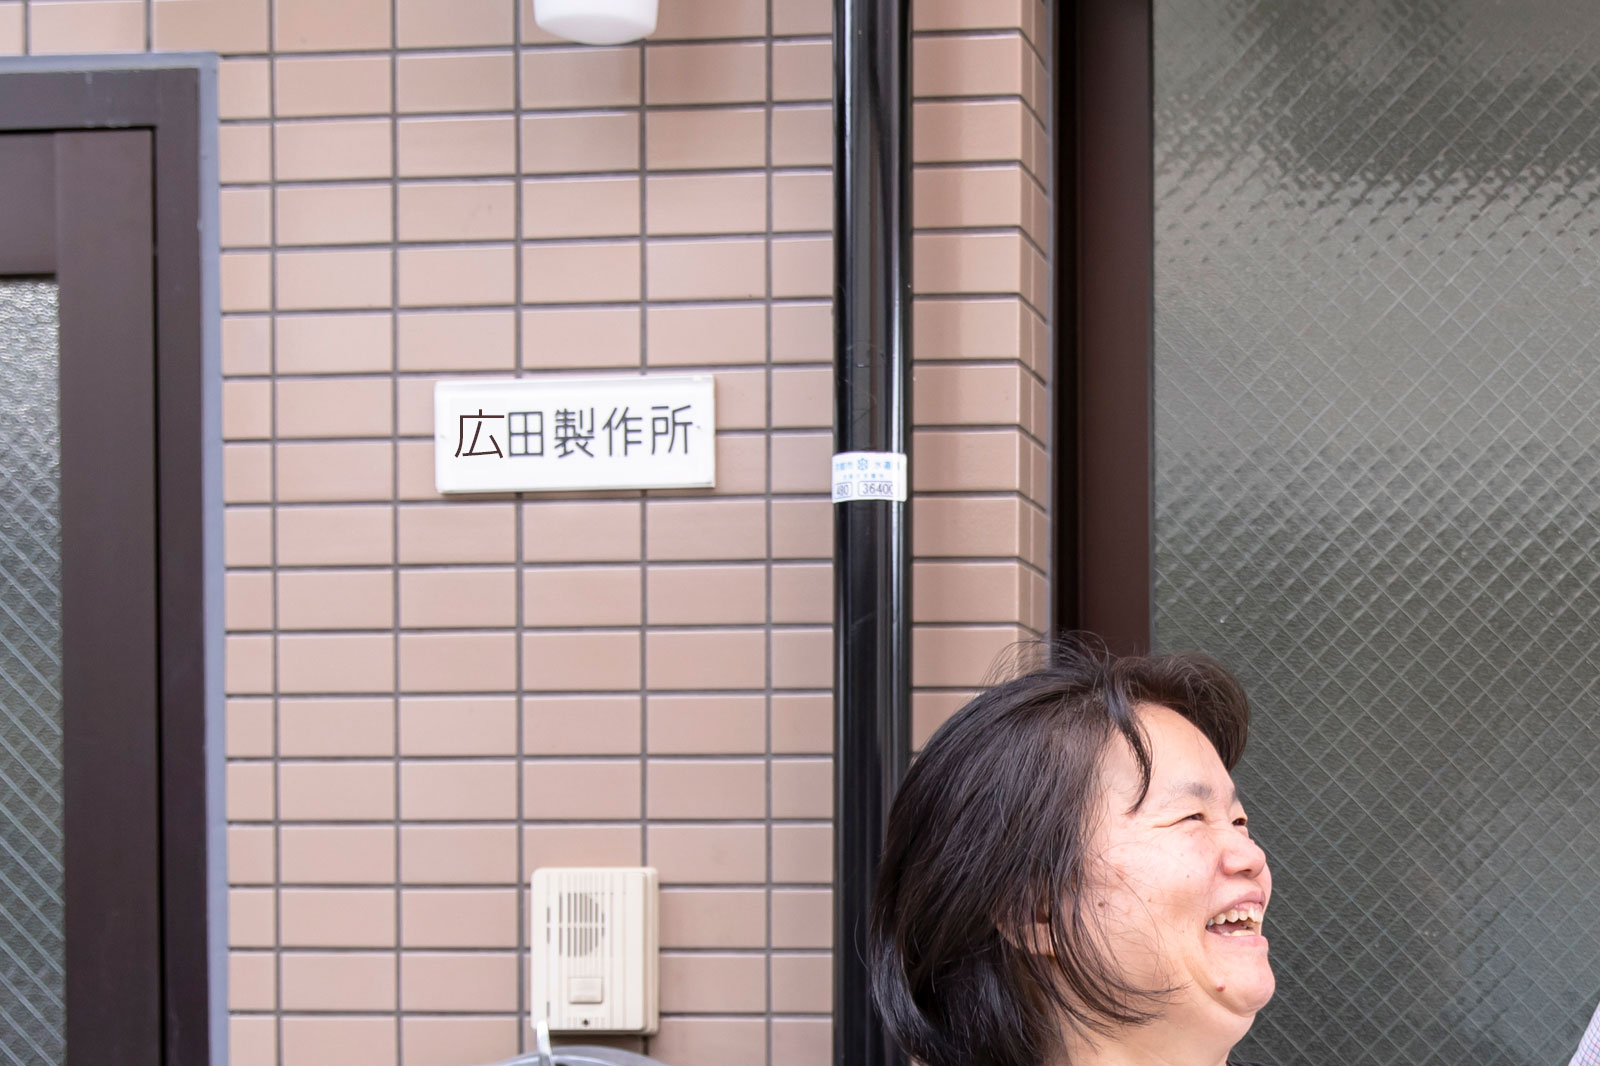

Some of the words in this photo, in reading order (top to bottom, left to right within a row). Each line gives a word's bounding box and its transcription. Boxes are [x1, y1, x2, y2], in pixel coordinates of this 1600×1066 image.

[455, 405, 693, 458] 広田製作所
